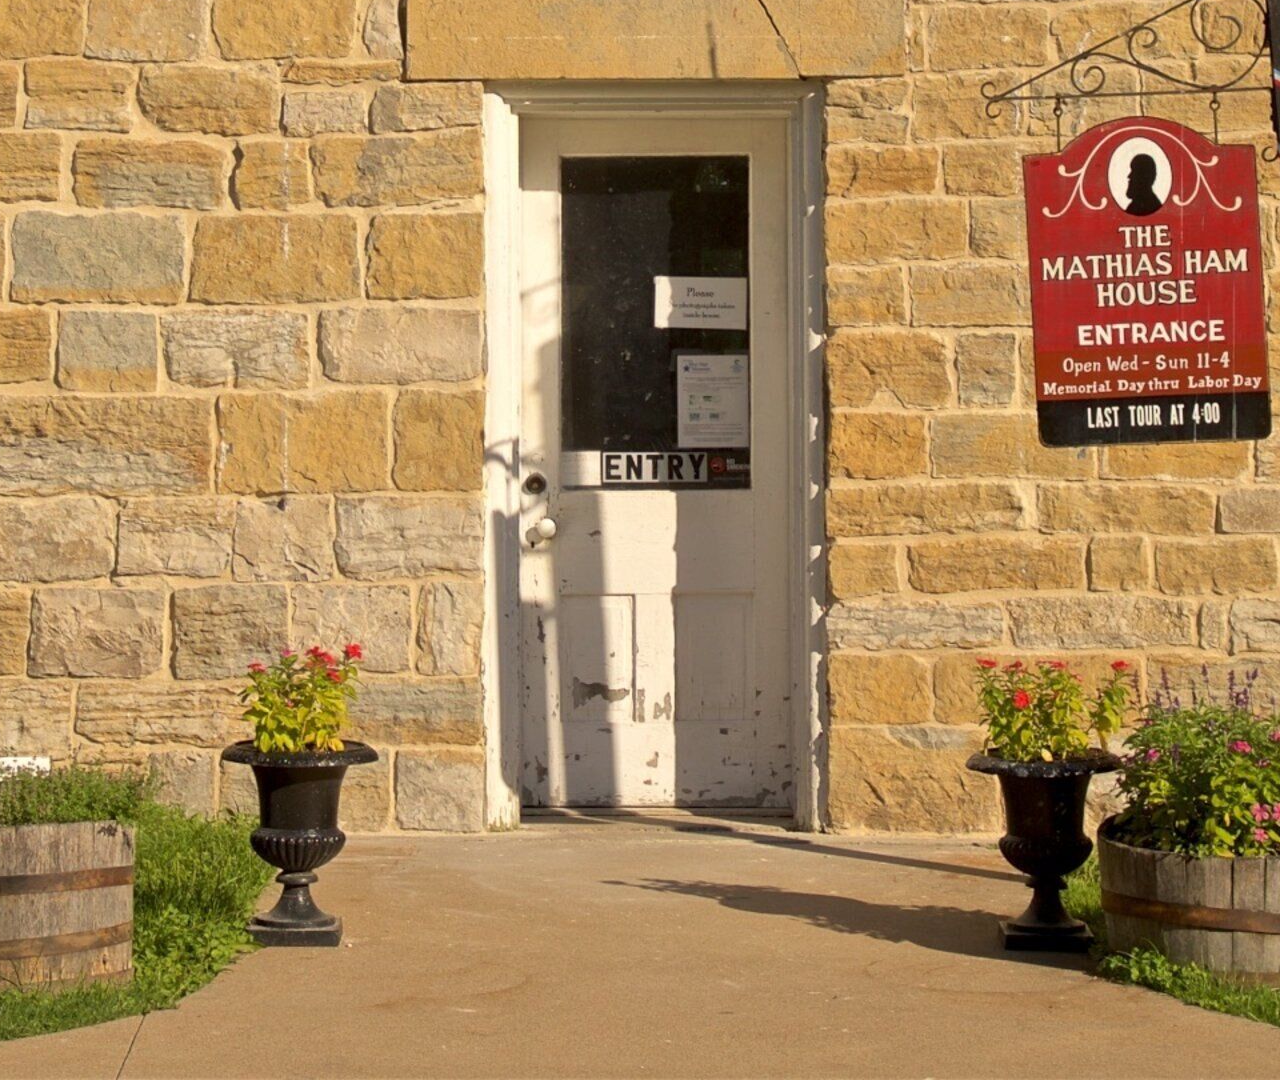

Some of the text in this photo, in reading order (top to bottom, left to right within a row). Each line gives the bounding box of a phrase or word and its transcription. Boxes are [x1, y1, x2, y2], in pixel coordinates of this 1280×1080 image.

[1119, 225, 1171, 248] THE
[1041, 248, 1249, 281] MATHIAS HAM
[1097, 280, 1197, 307] HOUSE
[1078, 319, 1226, 346] ENTRANCE
[1062, 357, 1101, 377] Open
[1106, 354, 1139, 372] Wed
[1155, 354, 1189, 370] Sun
[1197, 350, 1230, 369] 11-4
[1043, 374, 1262, 395] Memorial Day thru Labor Day
[1087, 401, 1221, 429] LAST TOUR AT 4:00
[605, 454, 705, 480] ENTRY
